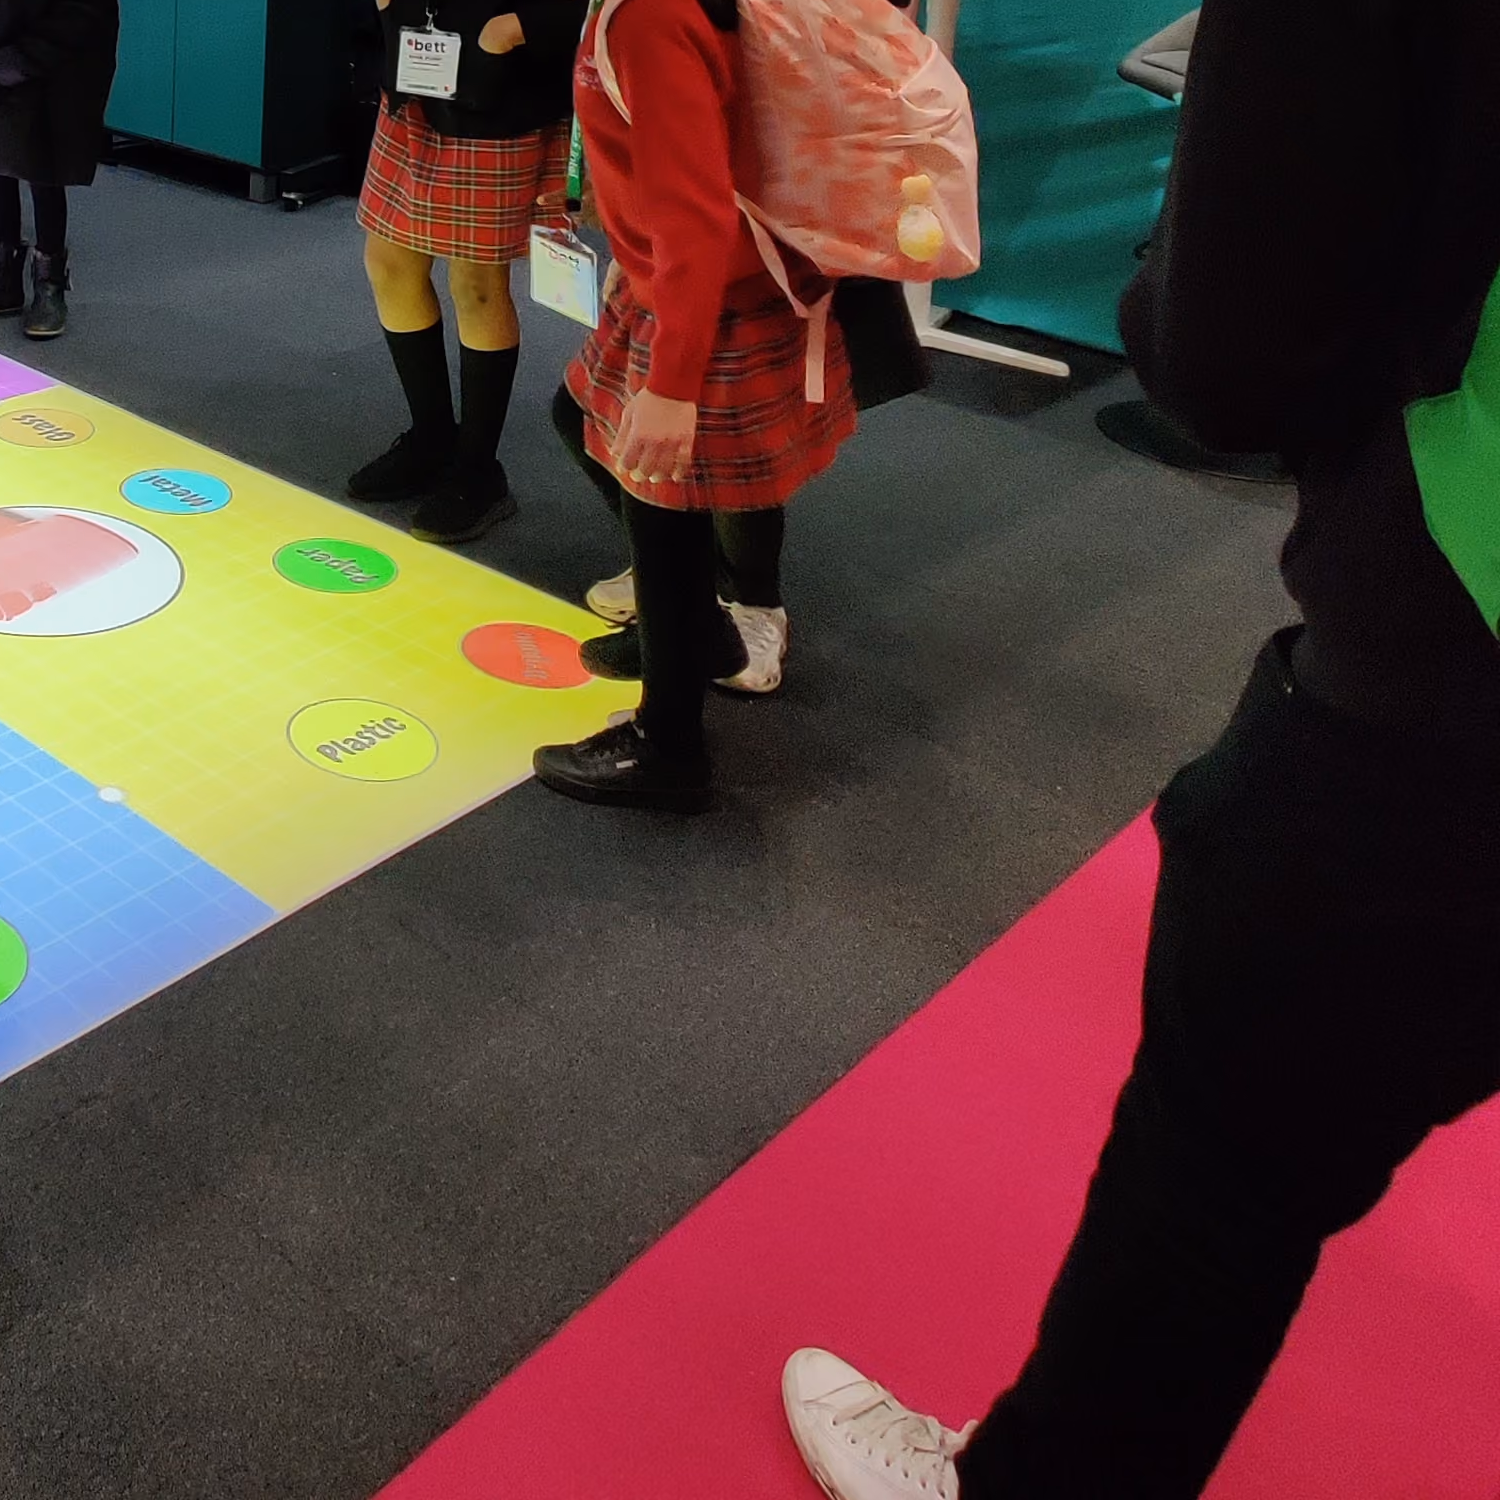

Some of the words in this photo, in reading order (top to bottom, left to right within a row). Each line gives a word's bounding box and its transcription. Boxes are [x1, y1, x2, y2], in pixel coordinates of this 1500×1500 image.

[414, 38, 446, 53] bett
[12, 414, 77, 443] Glass
[136, 473, 213, 509] Metal
[294, 546, 381, 585] Paper
[315, 714, 408, 764] Plastic
